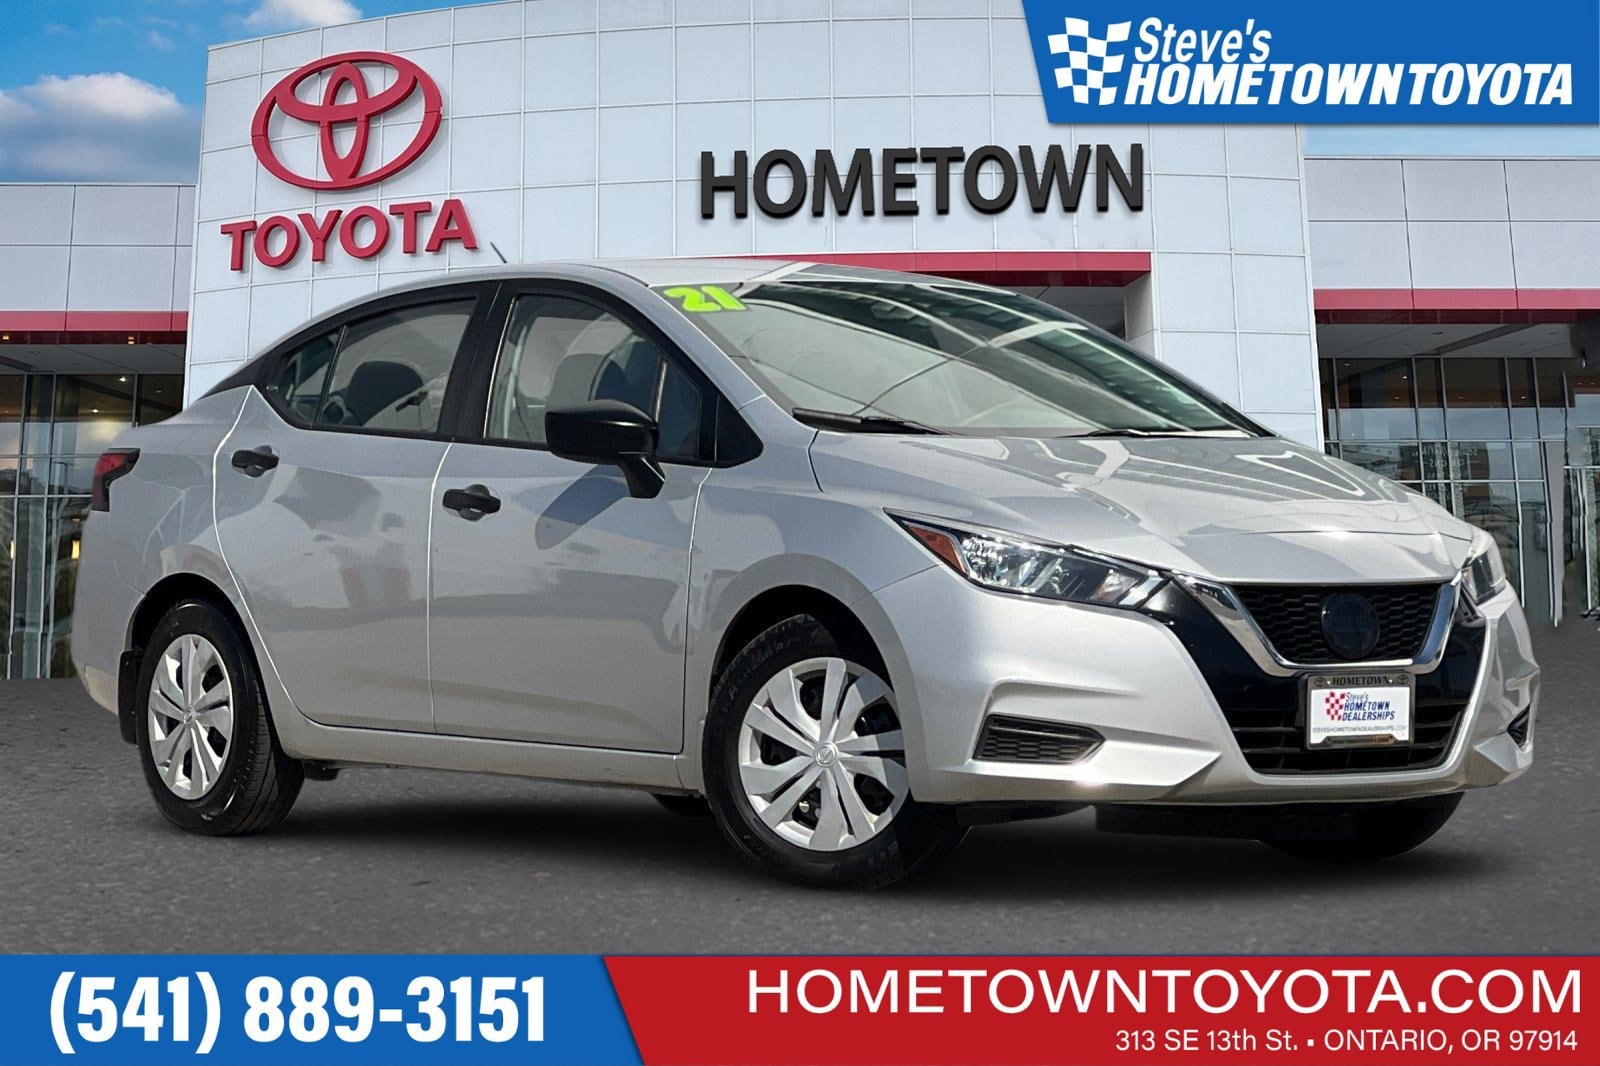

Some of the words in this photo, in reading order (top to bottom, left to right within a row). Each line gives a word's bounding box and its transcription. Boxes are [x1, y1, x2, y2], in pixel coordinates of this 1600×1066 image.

[700, 144, 1144, 219] HOMETOWN
[220, 198, 477, 271] TOYOTA
[663, 285, 746, 312] 21
[1342, 711, 1395, 721] DEALERSHIPS
[1344, 701, 1390, 711] HOMETOWN
